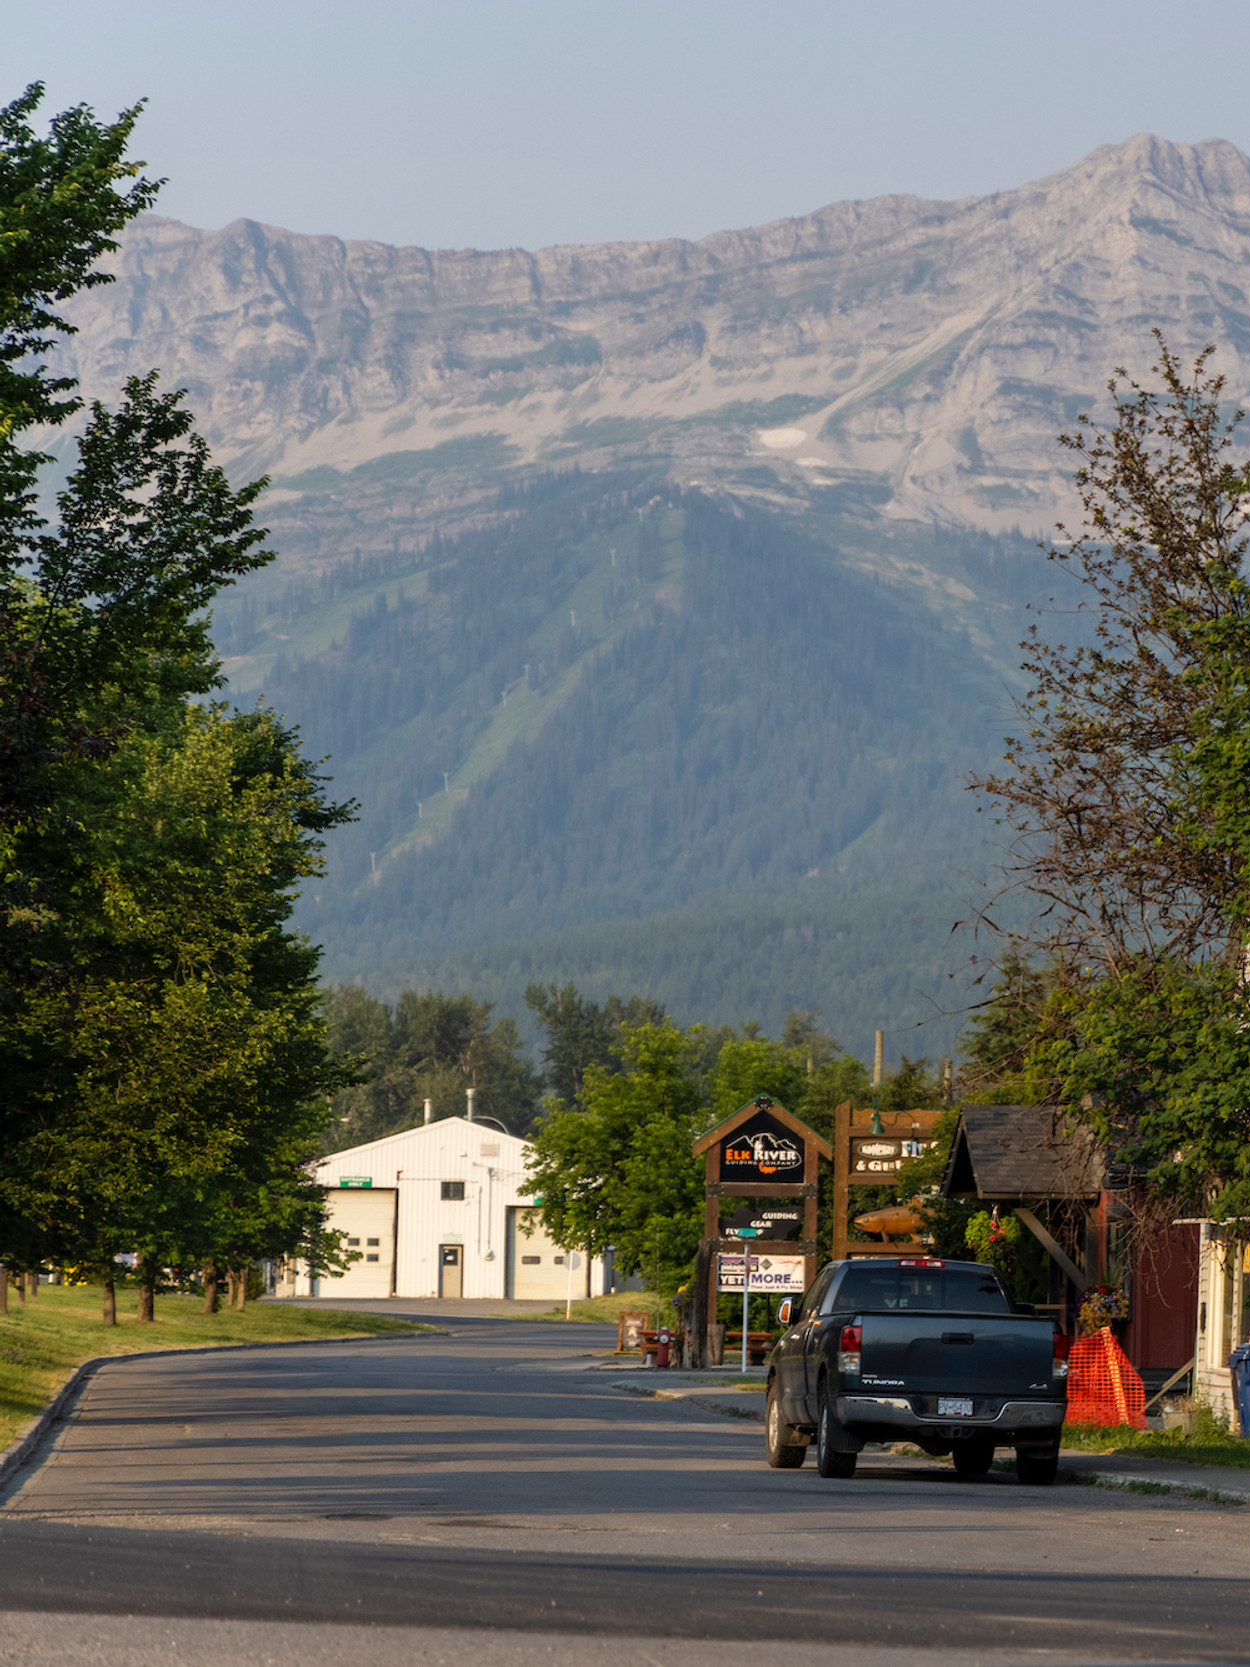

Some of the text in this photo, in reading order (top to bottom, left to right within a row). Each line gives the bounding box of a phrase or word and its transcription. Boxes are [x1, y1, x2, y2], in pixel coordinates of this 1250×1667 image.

[725, 1148, 797, 1160] ELK RIVER
[856, 1160, 866, 1171] &
[762, 1212, 798, 1220] GUIDING
[725, 1227, 739, 1235] FLY
[720, 1275, 746, 1285] YET
